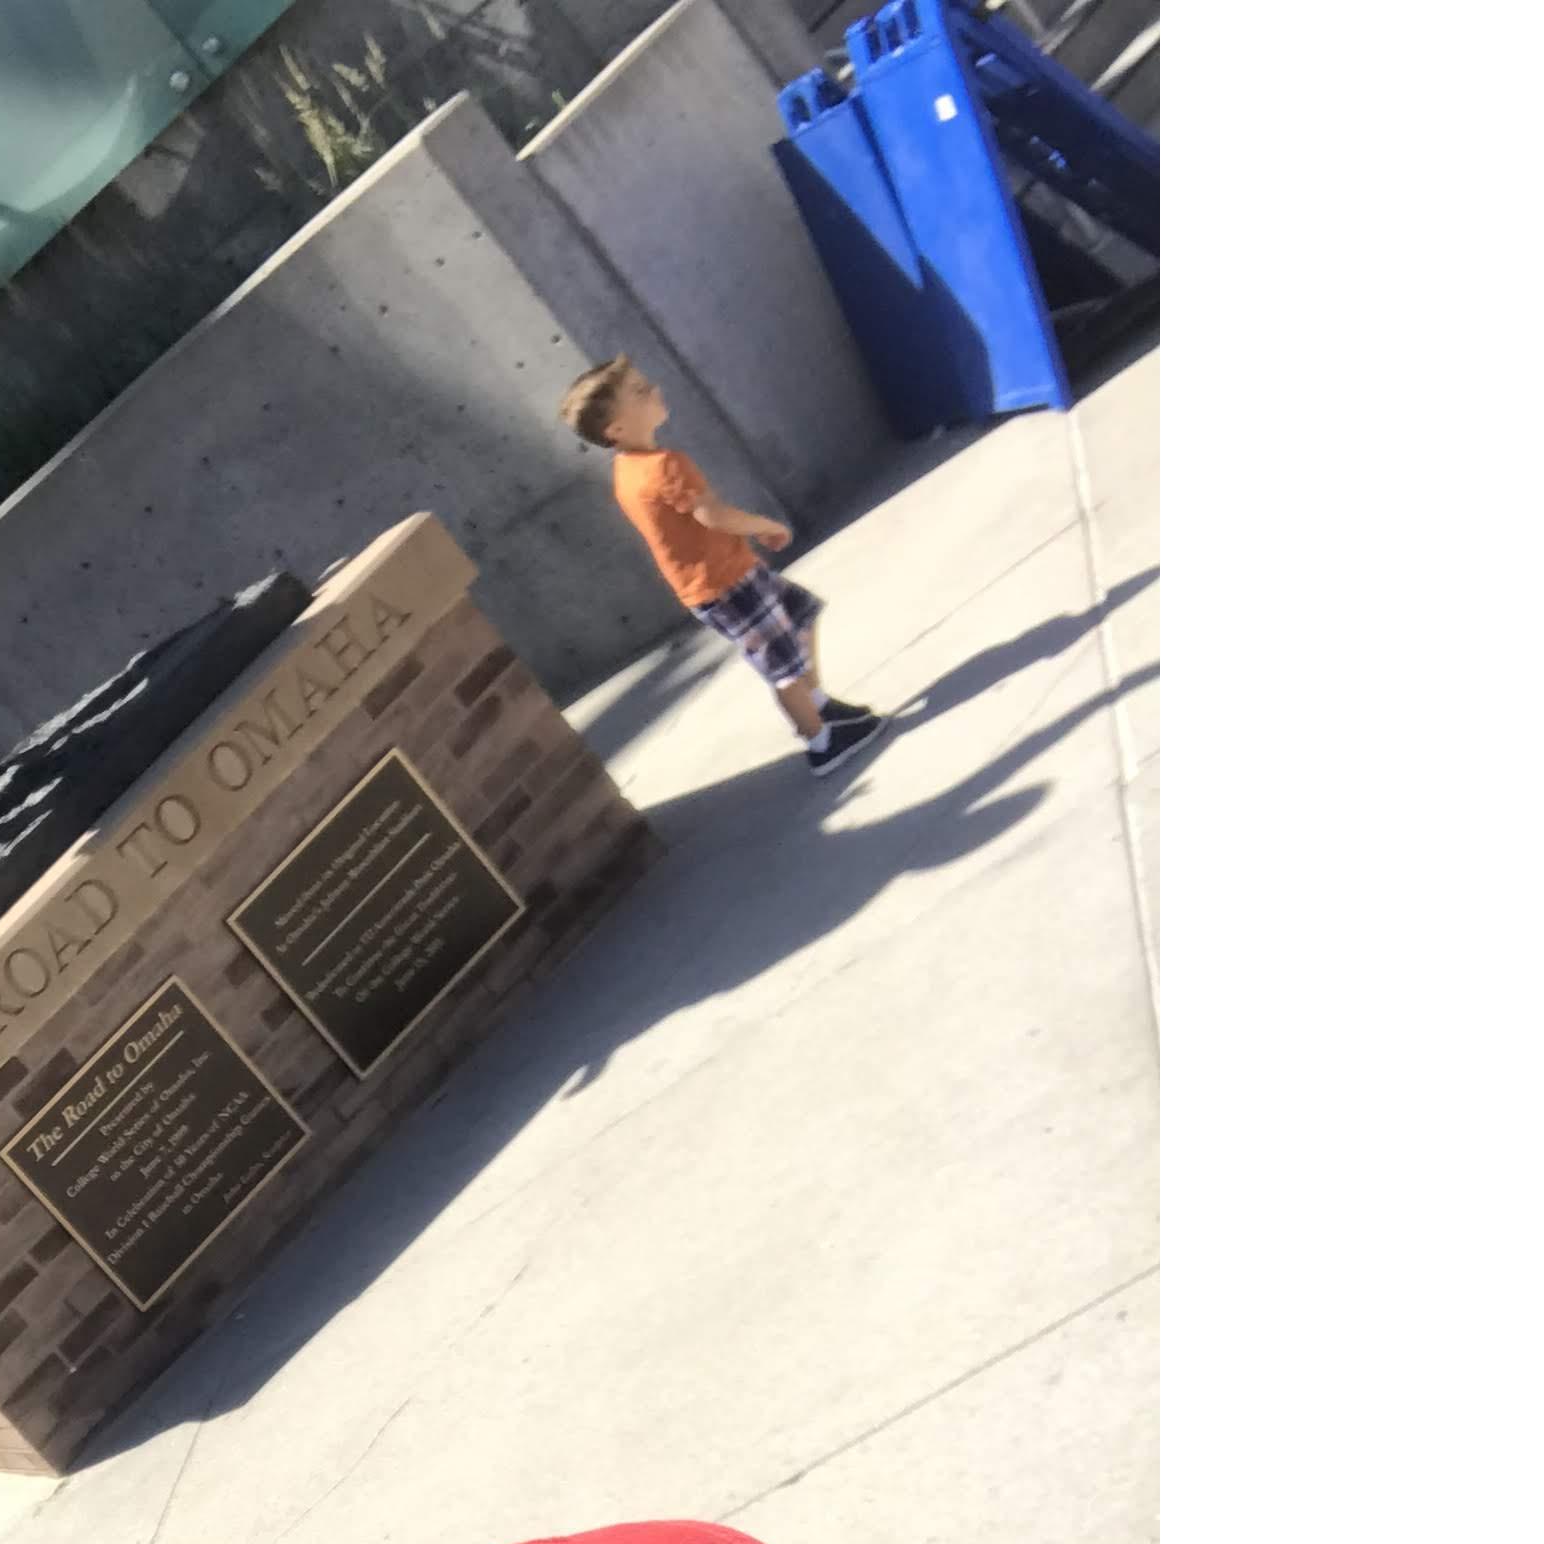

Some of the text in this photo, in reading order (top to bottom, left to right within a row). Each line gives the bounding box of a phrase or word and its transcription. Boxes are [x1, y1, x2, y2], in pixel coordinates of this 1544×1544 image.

[118, 795, 202, 878] TO
[208, 591, 413, 793] OMAHA
[26, 1003, 182, 1161] The Road to Omaha
[65, 1164, 100, 1198] College
[96, 1136, 125, 1164] World
[122, 1112, 150, 1139] Series
[148, 1099, 160, 1113] of
[159, 1068, 195, 1101] Omaha,
[99, 1080, 155, 1136] Presented by
[118, 1154, 135, 1171] the
[132, 1136, 153, 1156] City
[151, 1123, 164, 1137] of
[161, 1092, 195, 1125] Omaha
[104, 1225, 118, 1239] In
[116, 1178, 165, 1227] Celebration
[162, 1165, 175, 1180] of
[183, 1131, 210, 1156] Years
[207, 1119, 219, 1133] of
[217, 1091, 248, 1118] NCAA
[106, 1227, 144, 1264] Division
[147, 1183, 184, 1221] Baseball
[181, 1124, 243, 1186] Championship
[139, 1154, 161, 1178] June
[190, 1171, 223, 1204] Omaha
